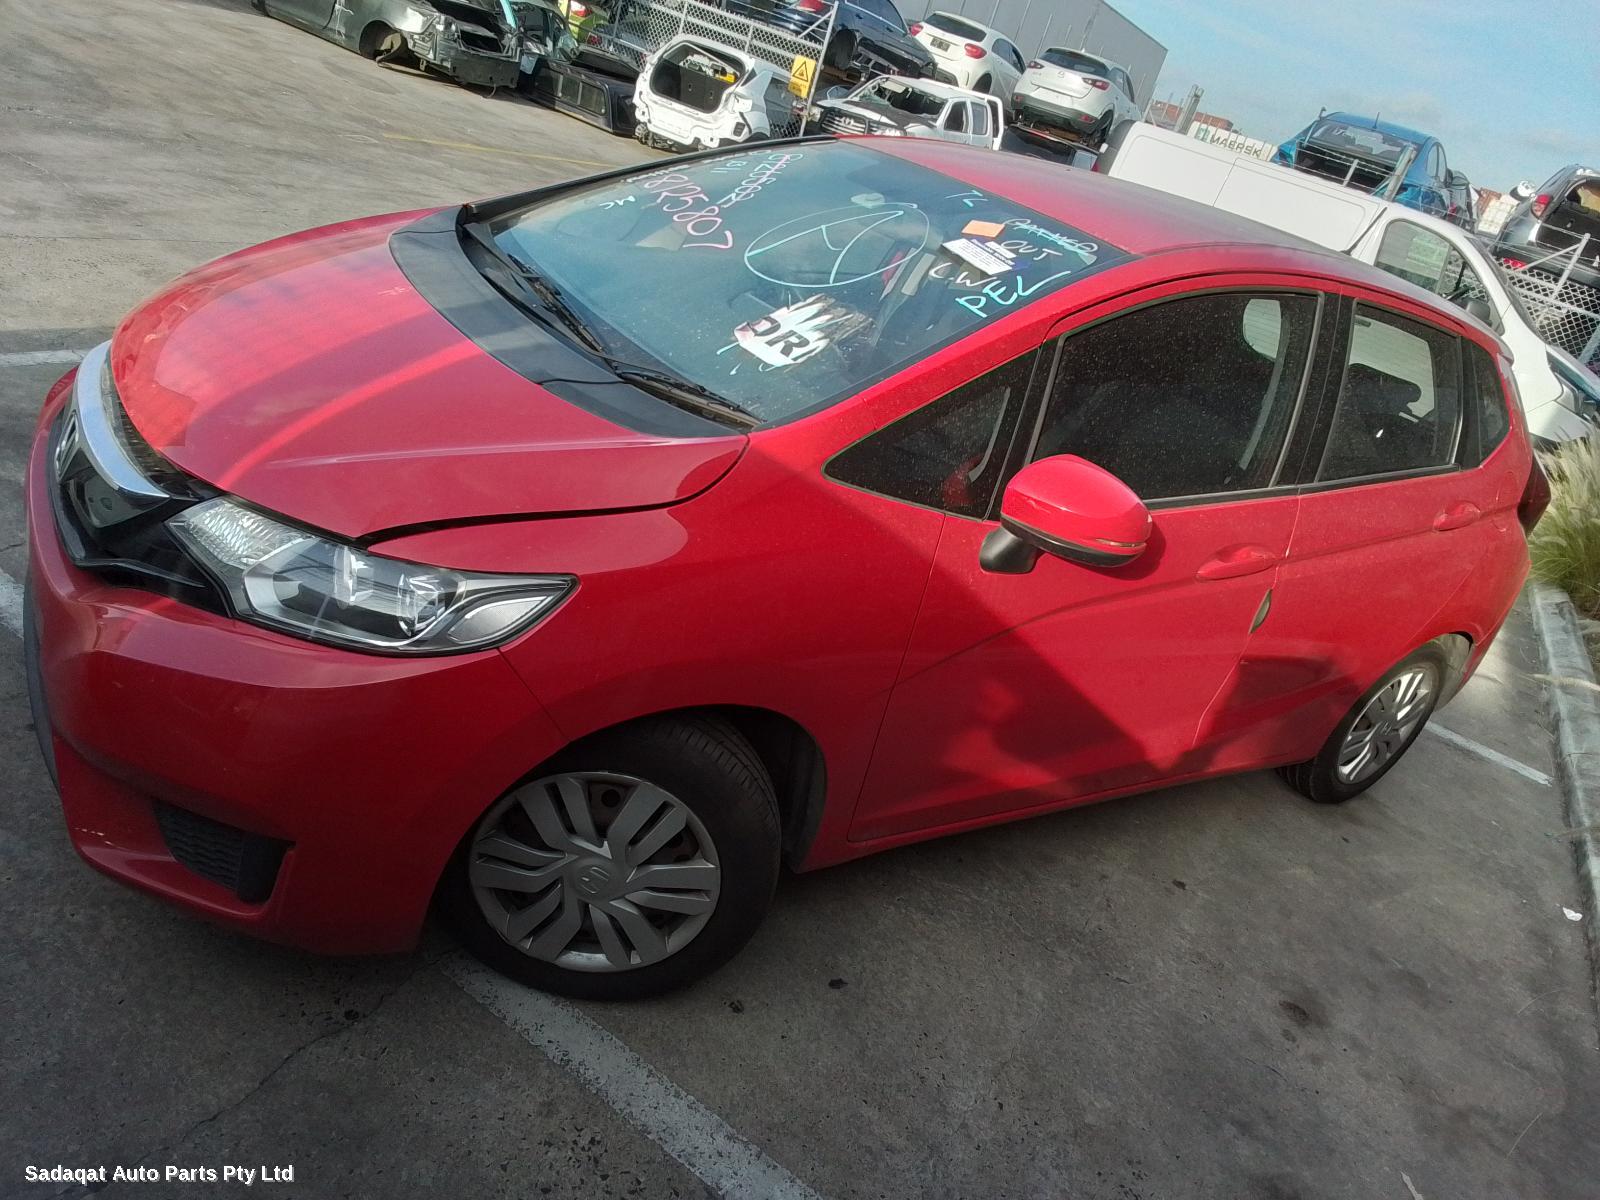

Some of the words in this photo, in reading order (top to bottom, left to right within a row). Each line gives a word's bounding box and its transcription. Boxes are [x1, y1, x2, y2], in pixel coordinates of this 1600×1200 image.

[1210, 134, 1262, 158] MAERSK
[1000, 239, 1064, 261] OUT
[955, 270, 1072, 318] PEL
